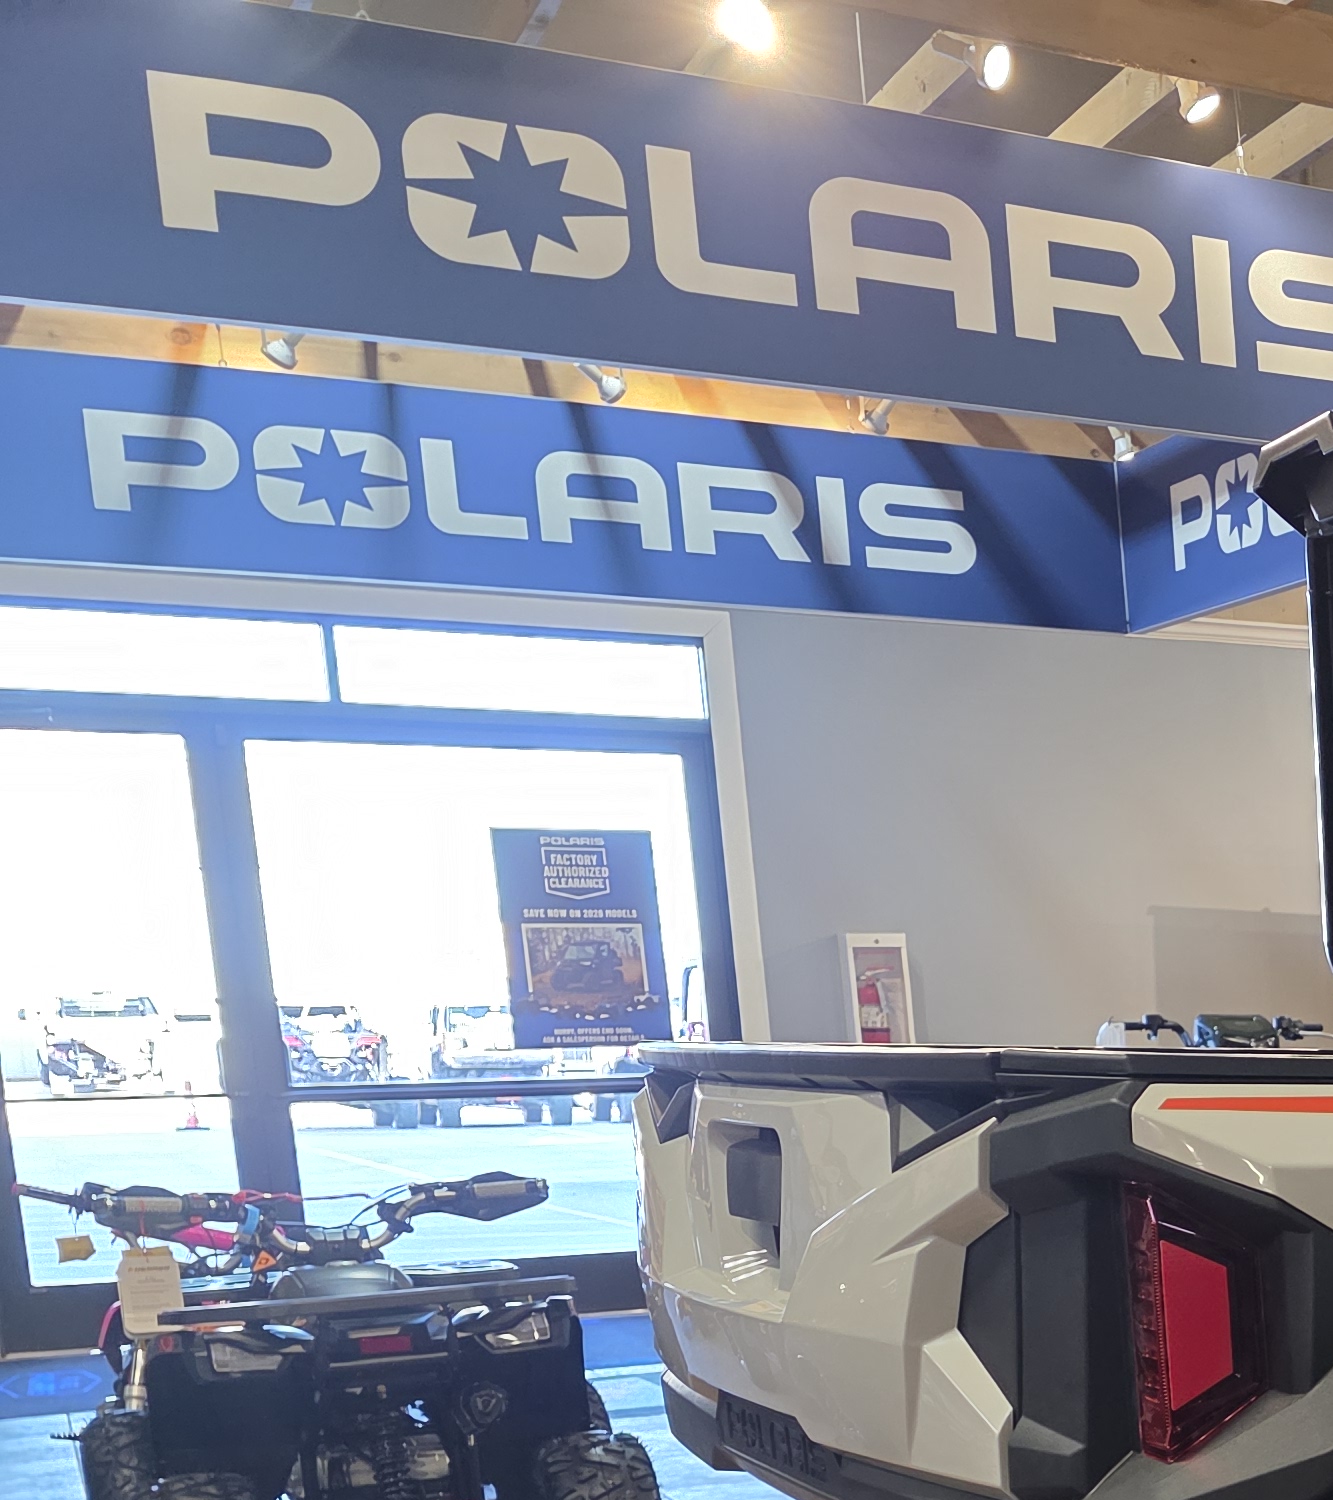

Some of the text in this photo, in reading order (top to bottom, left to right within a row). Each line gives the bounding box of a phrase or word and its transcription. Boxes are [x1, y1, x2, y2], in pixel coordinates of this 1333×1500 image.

[83, 408, 977, 575] POLARIS
[539, 836, 604, 846] POLARIS
[550, 853, 597, 865] FACTORY
[543, 866, 609, 877] AUTHORIZED
[549, 878, 605, 888] CLEARANCE
[523, 909, 545, 918] SAVE
[547, 909, 567, 918] NOW
[569, 909, 581, 918] ON
[605, 909, 637, 918] MODELS
